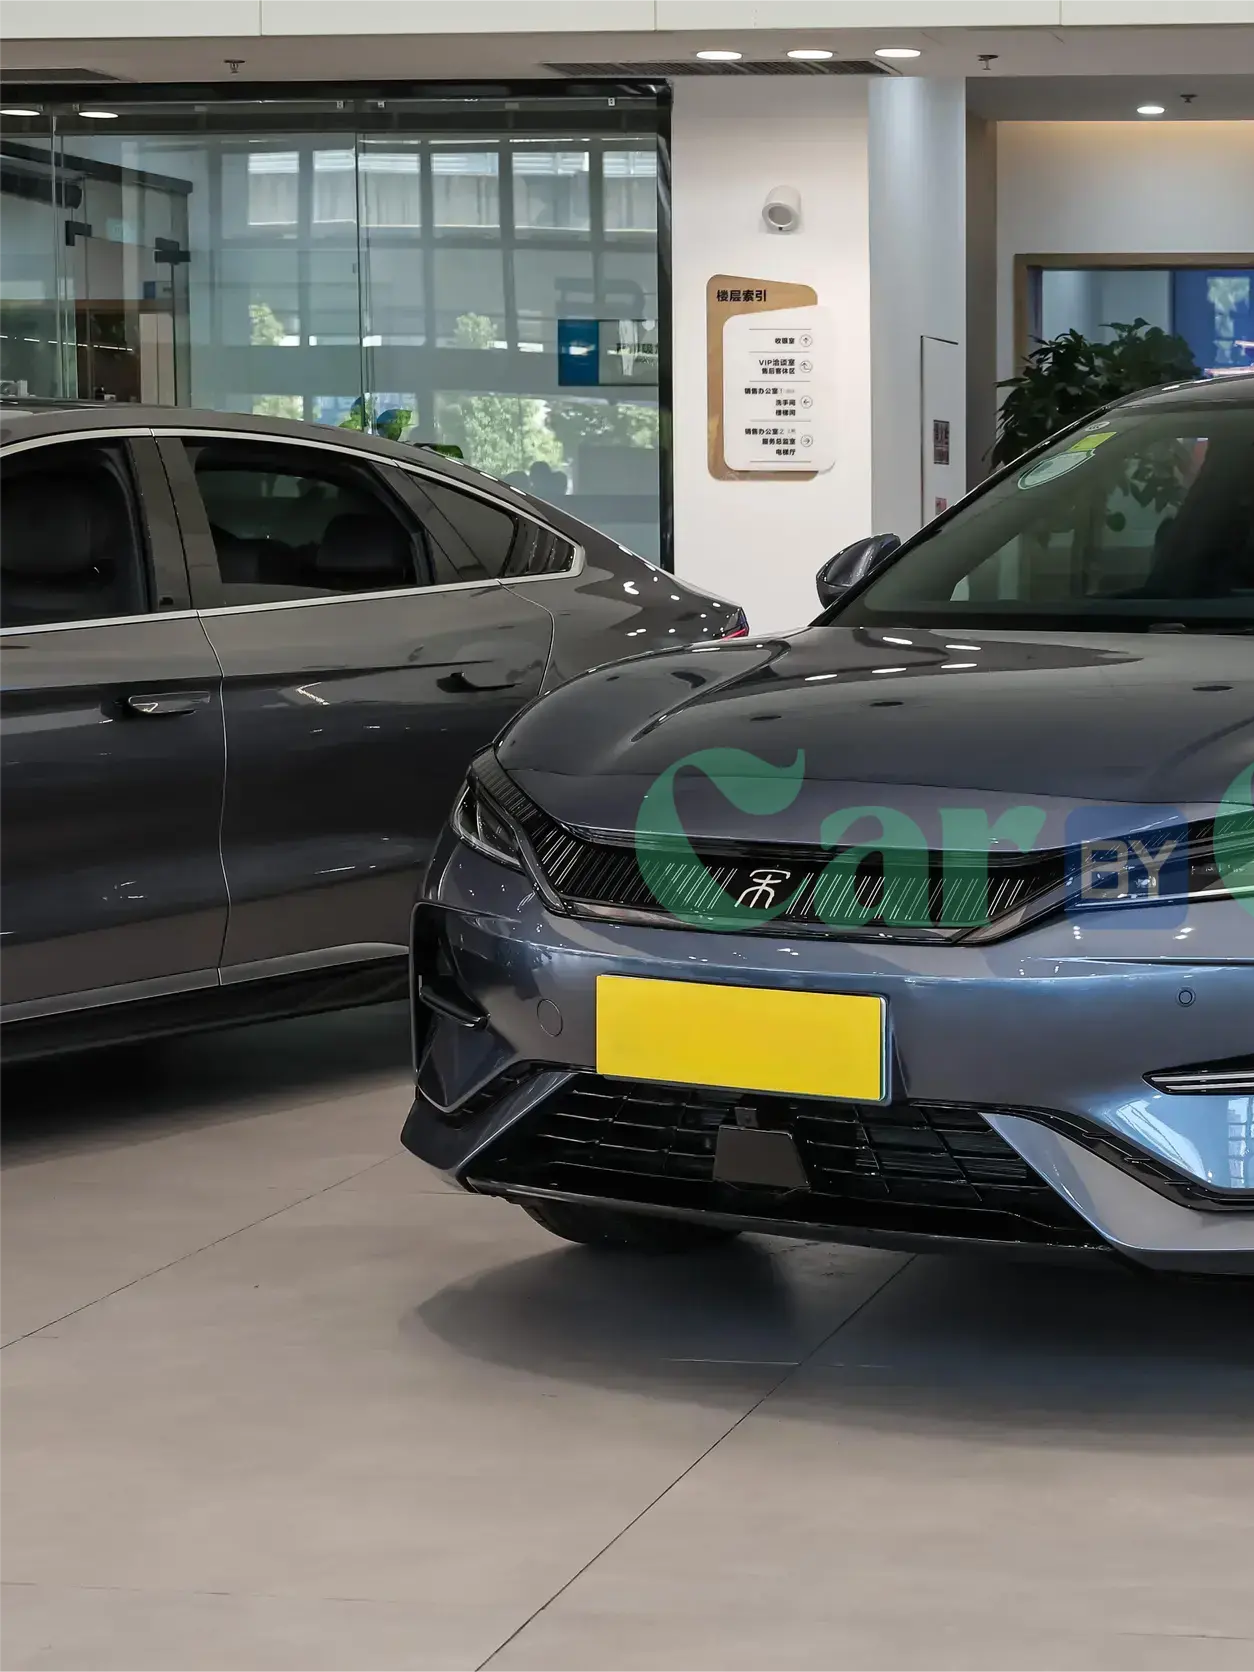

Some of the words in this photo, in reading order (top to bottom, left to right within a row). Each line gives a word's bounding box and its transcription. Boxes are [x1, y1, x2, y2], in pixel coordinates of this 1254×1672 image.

[716, 289, 767, 303] 楼层索引
[758, 358, 795, 367] VIP洽谈室
[775, 399, 796, 407] 洗手间
